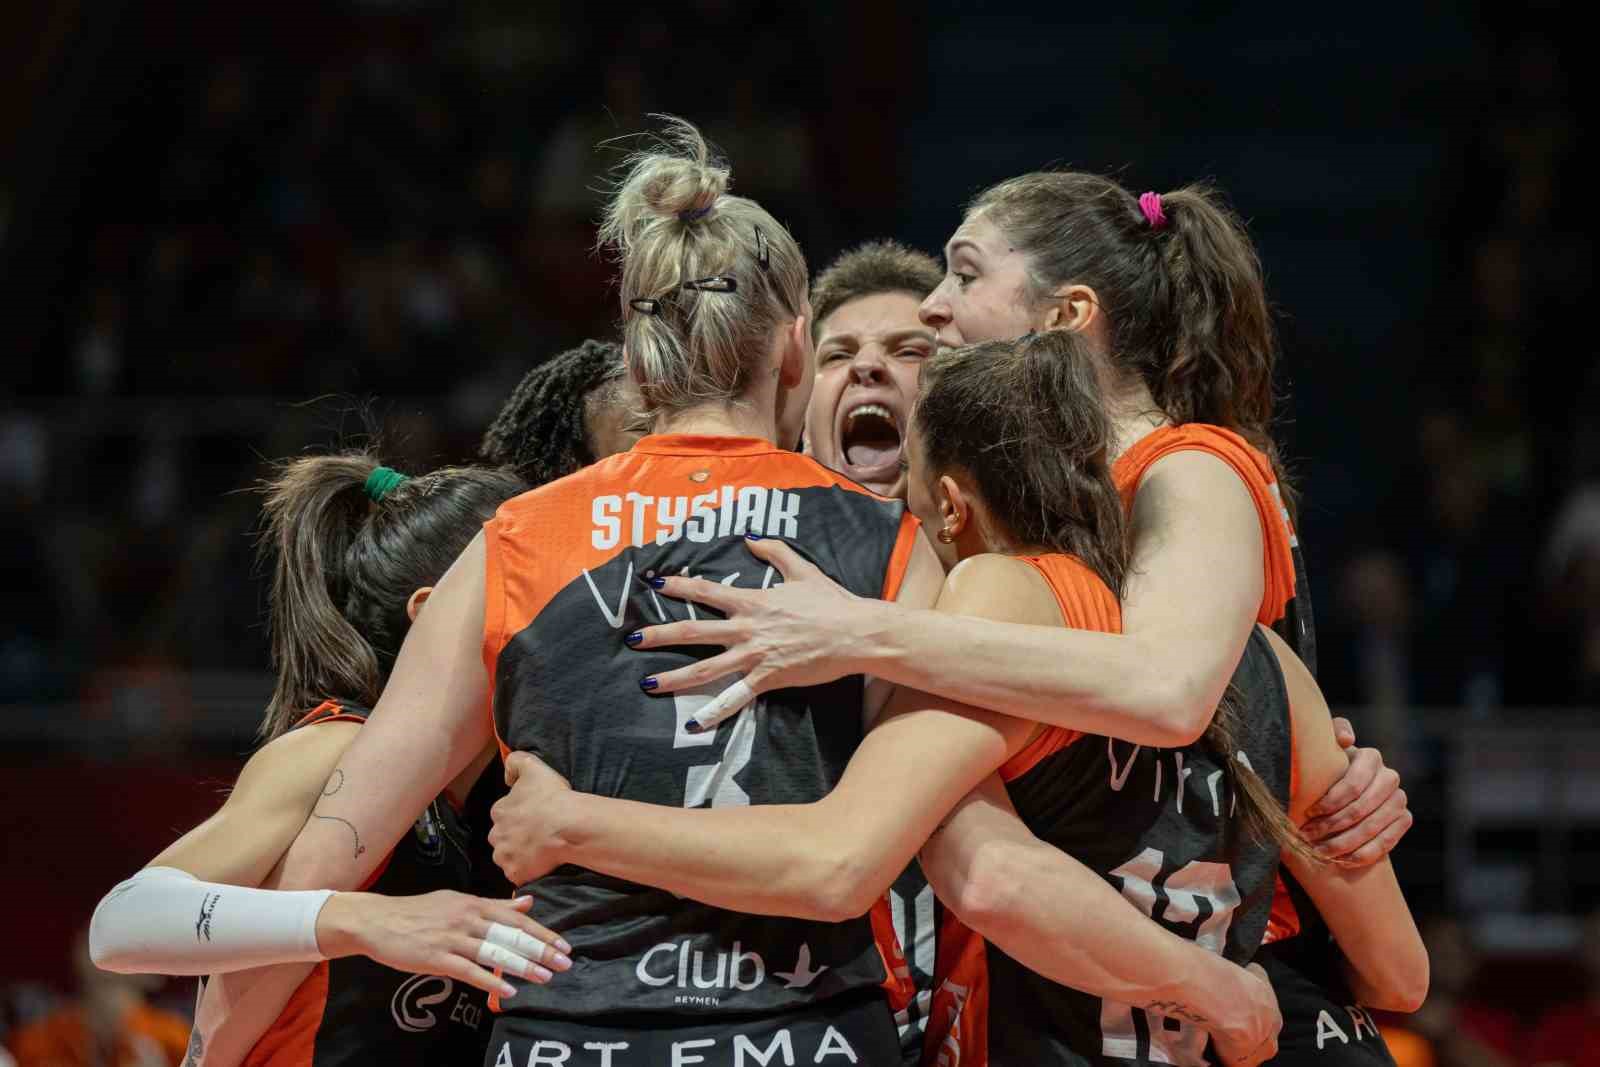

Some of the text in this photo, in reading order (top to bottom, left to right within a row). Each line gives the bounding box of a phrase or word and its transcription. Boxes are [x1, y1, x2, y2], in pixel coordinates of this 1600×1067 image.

[591, 485, 801, 550] STYSIAK
[635, 940, 765, 991] Club
[674, 996, 720, 1006] BEYMEN
